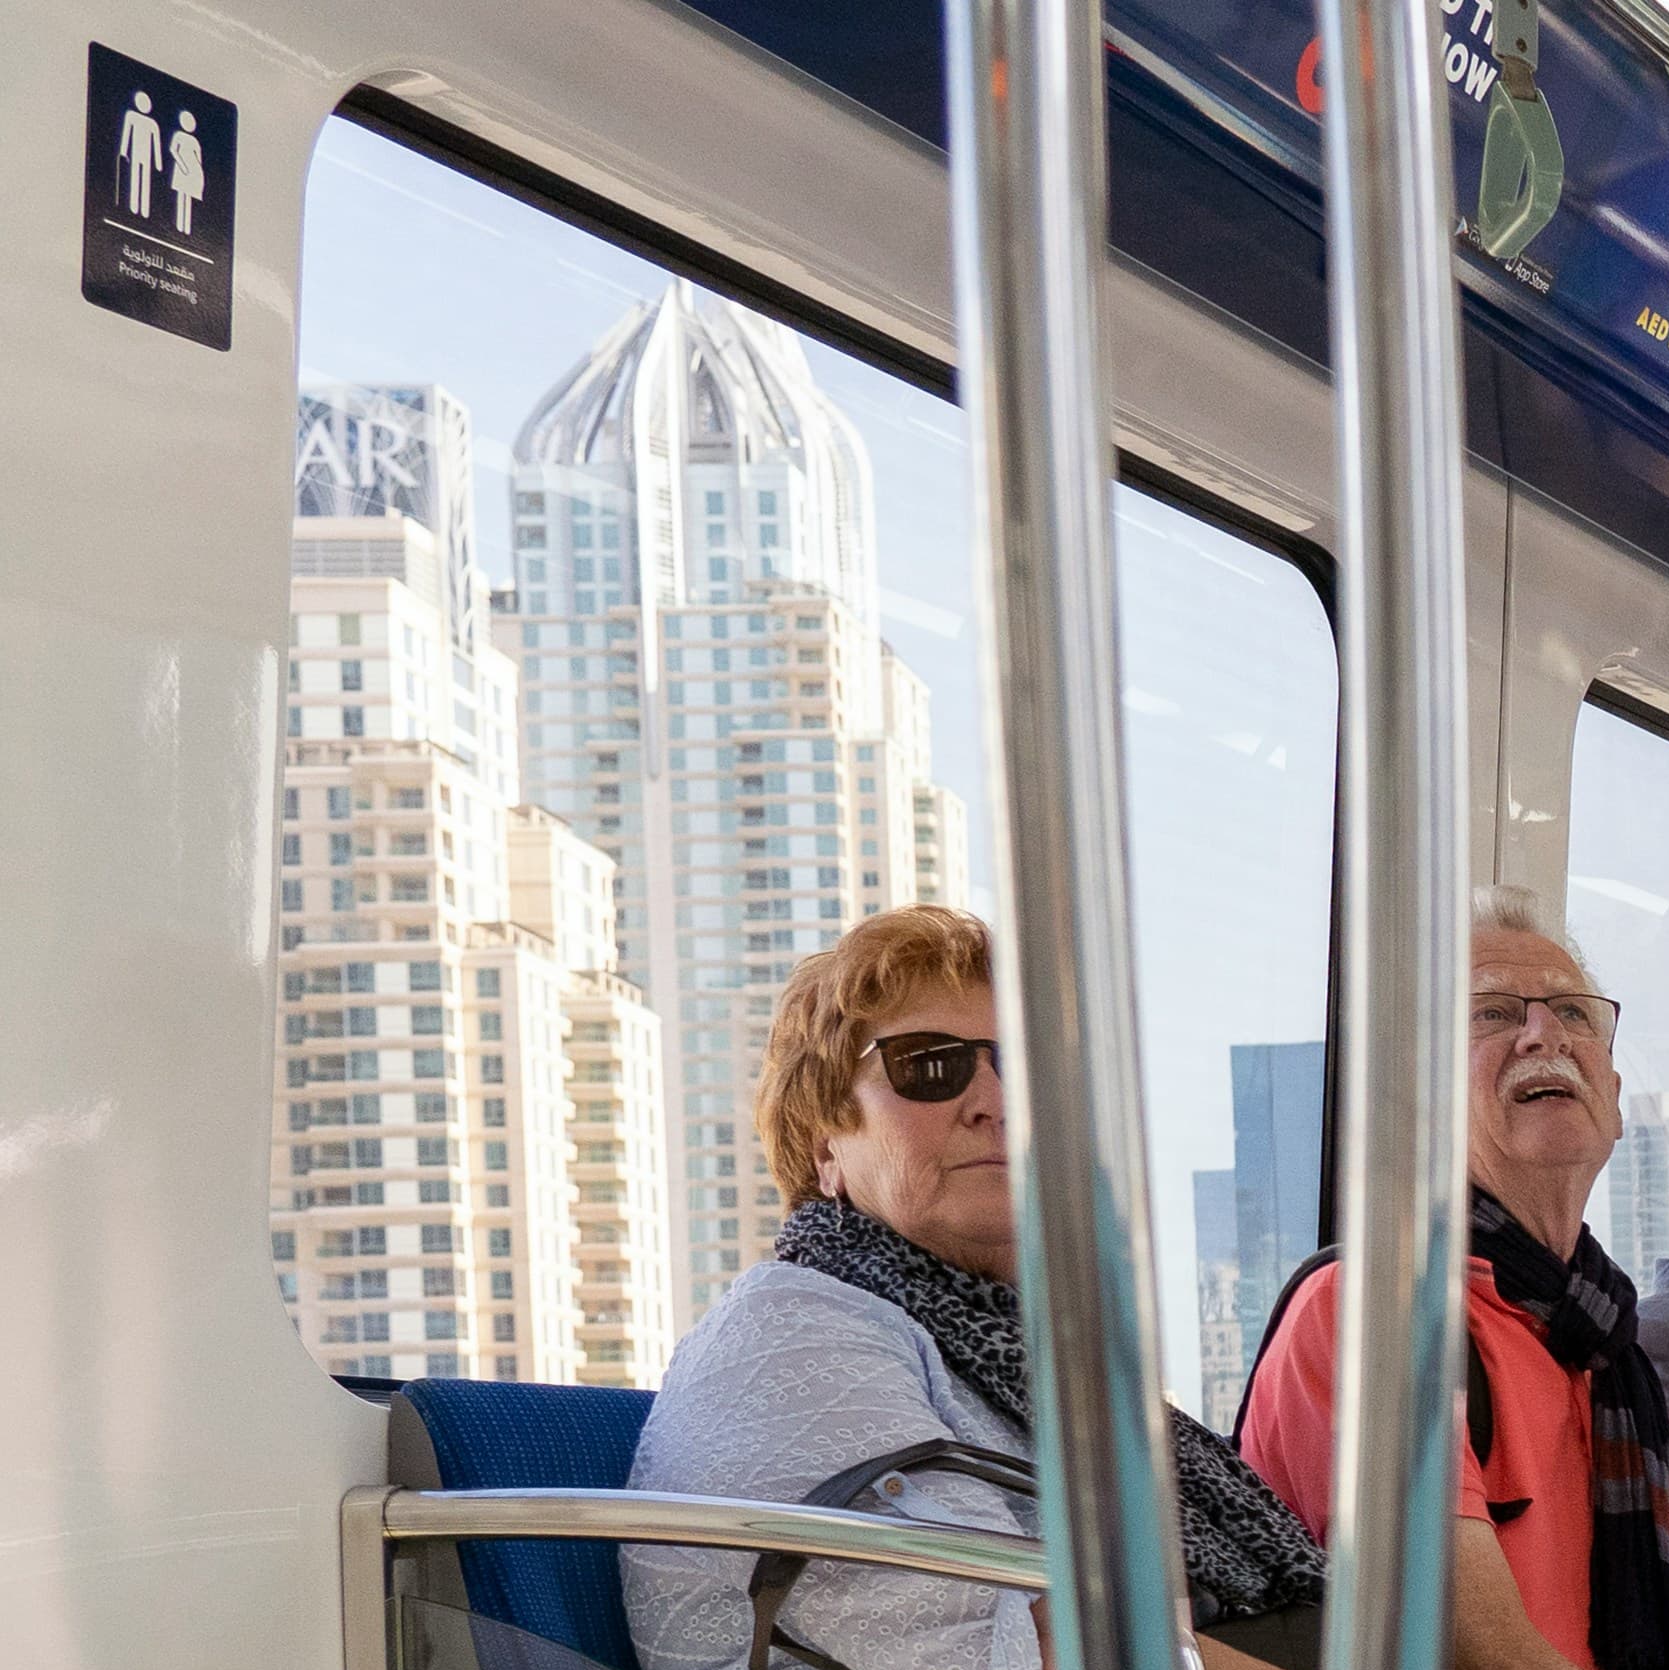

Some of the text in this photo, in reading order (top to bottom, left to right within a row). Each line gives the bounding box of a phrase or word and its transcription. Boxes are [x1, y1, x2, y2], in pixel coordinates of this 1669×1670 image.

[119, 261, 198, 305] Priority seating
[1513, 262, 1533, 286] App
[1530, 271, 1550, 295] Store
[1636, 306, 1669, 343] AED
